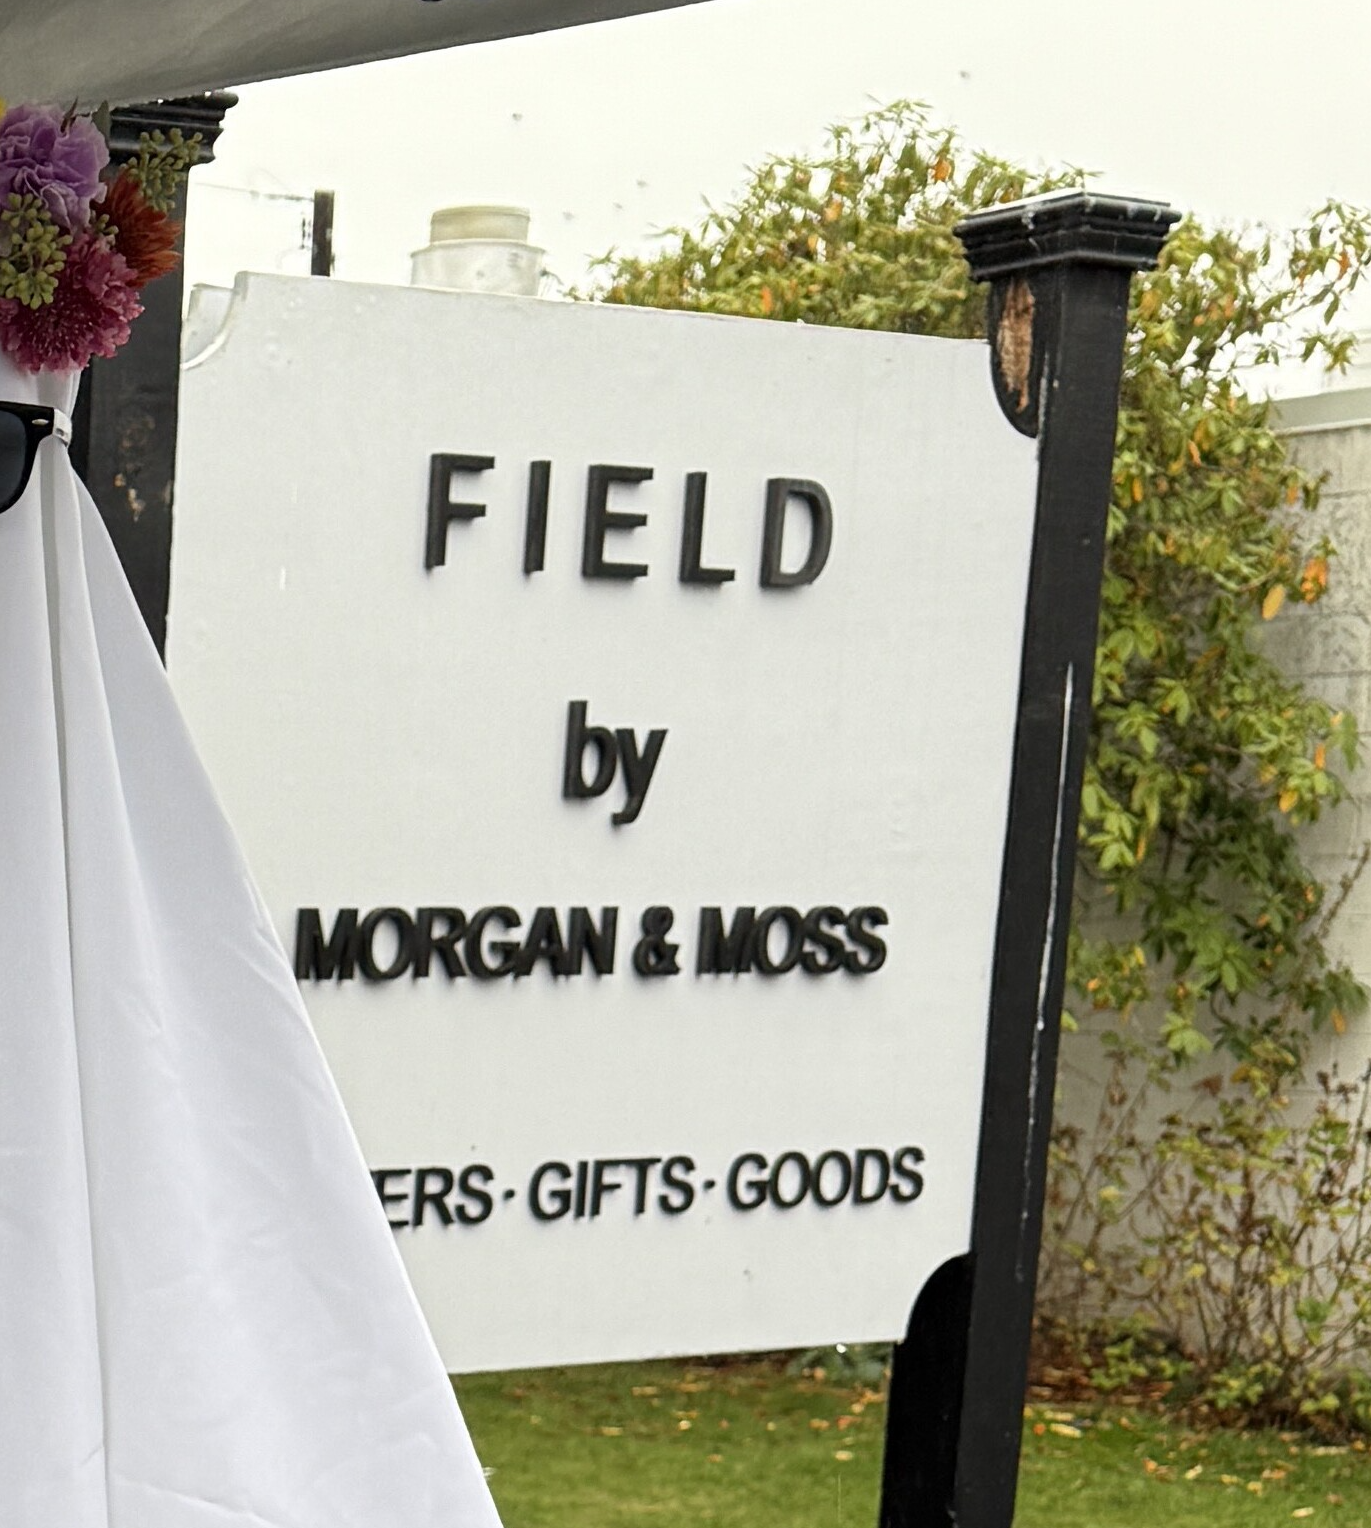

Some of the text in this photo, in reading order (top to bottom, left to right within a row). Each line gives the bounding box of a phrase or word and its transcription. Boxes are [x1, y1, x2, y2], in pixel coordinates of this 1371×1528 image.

[425, 453, 833, 588] FIELD
[563, 700, 668, 825] by
[294, 905, 890, 981] MORGAN & MOSS
